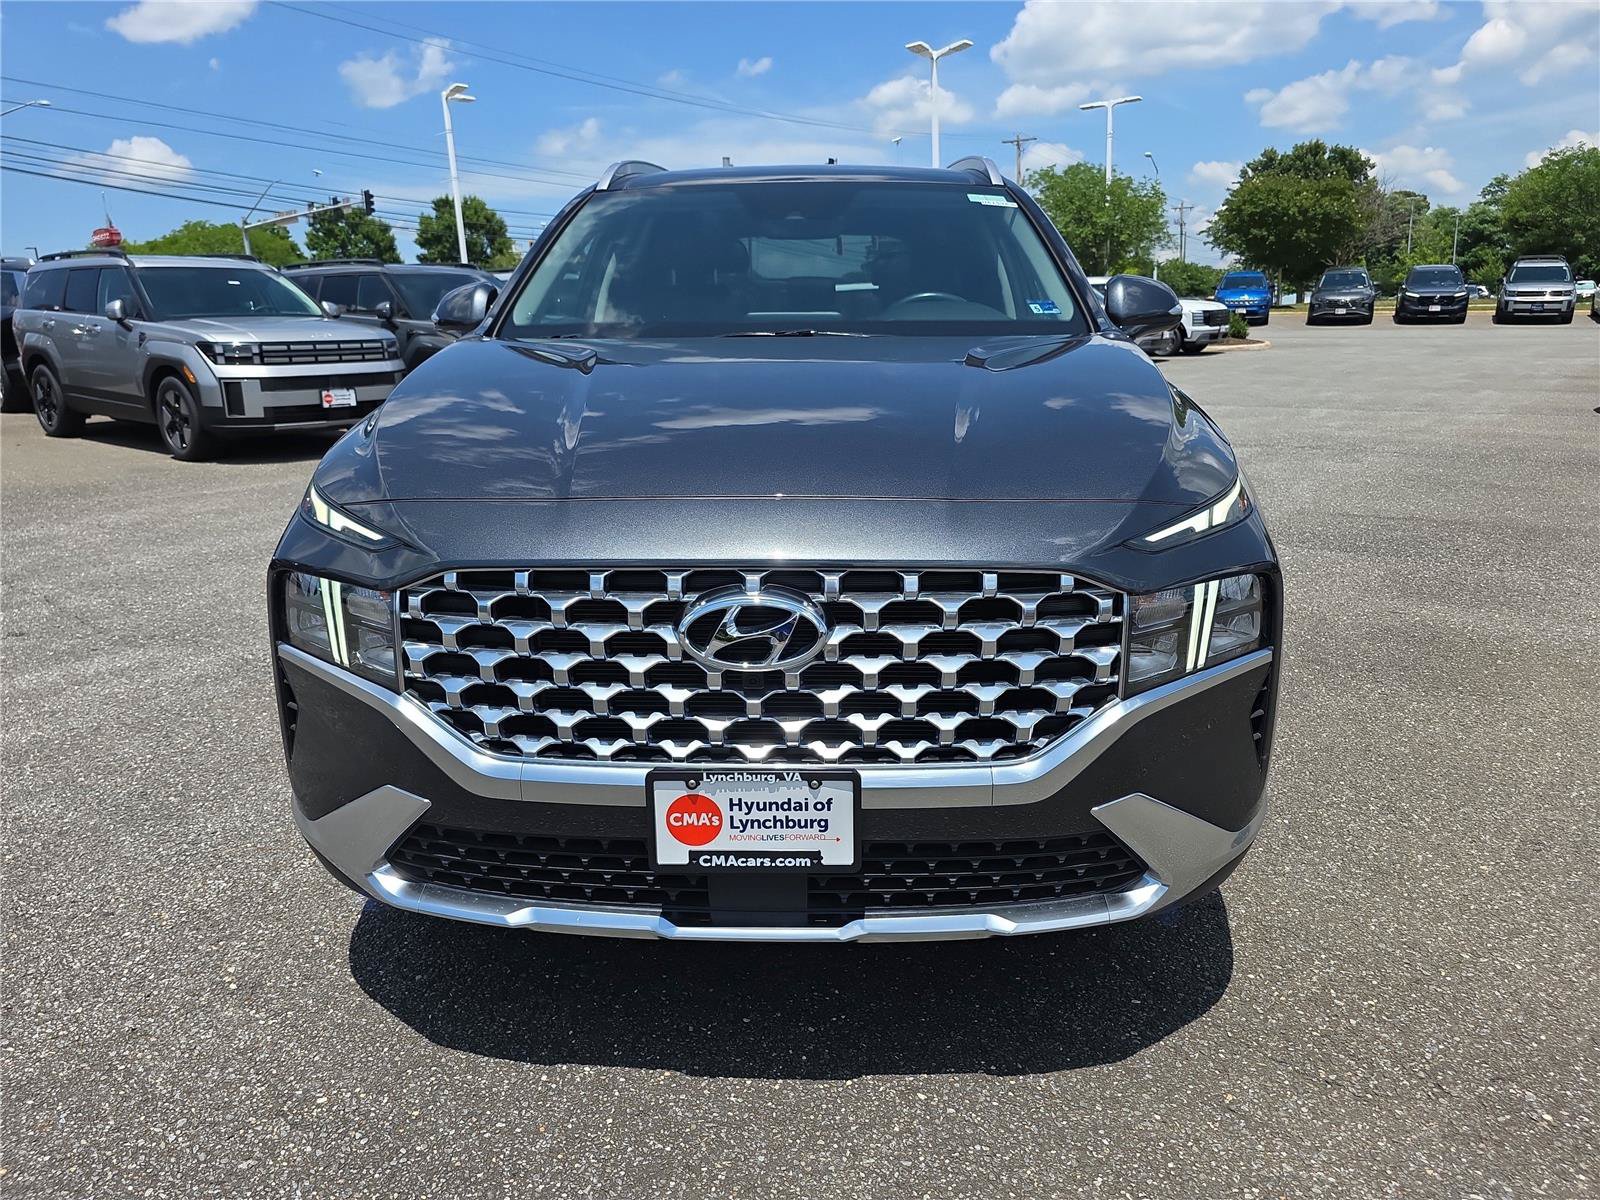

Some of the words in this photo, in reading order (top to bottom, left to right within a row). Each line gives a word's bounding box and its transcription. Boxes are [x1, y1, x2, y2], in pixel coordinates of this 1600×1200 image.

[703, 772, 780, 782] Lynchburg,
[783, 772, 803, 782] VA
[729, 798, 809, 815] Hyundai
[813, 798, 833, 812] of
[669, 813, 720, 827] CMA's
[729, 816, 829, 833] Lynchburg
[699, 855, 811, 867] CMAcars.com
